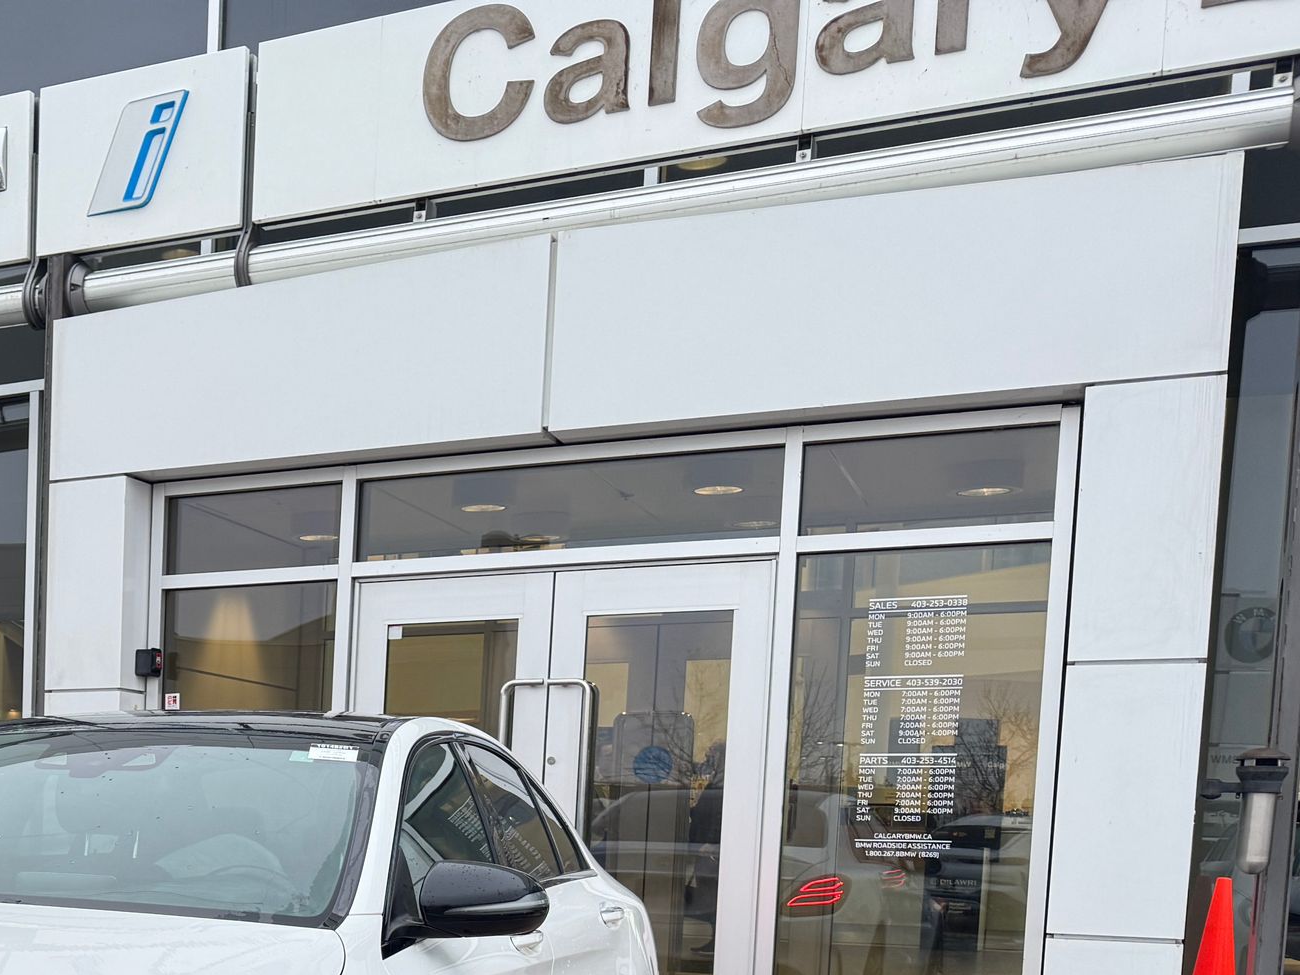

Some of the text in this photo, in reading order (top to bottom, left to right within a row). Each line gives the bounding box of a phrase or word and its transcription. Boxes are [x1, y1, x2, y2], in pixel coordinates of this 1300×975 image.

[869, 599, 968, 610] SALES 403-253-0338
[864, 678, 963, 687] SERVICE 403-539-2030
